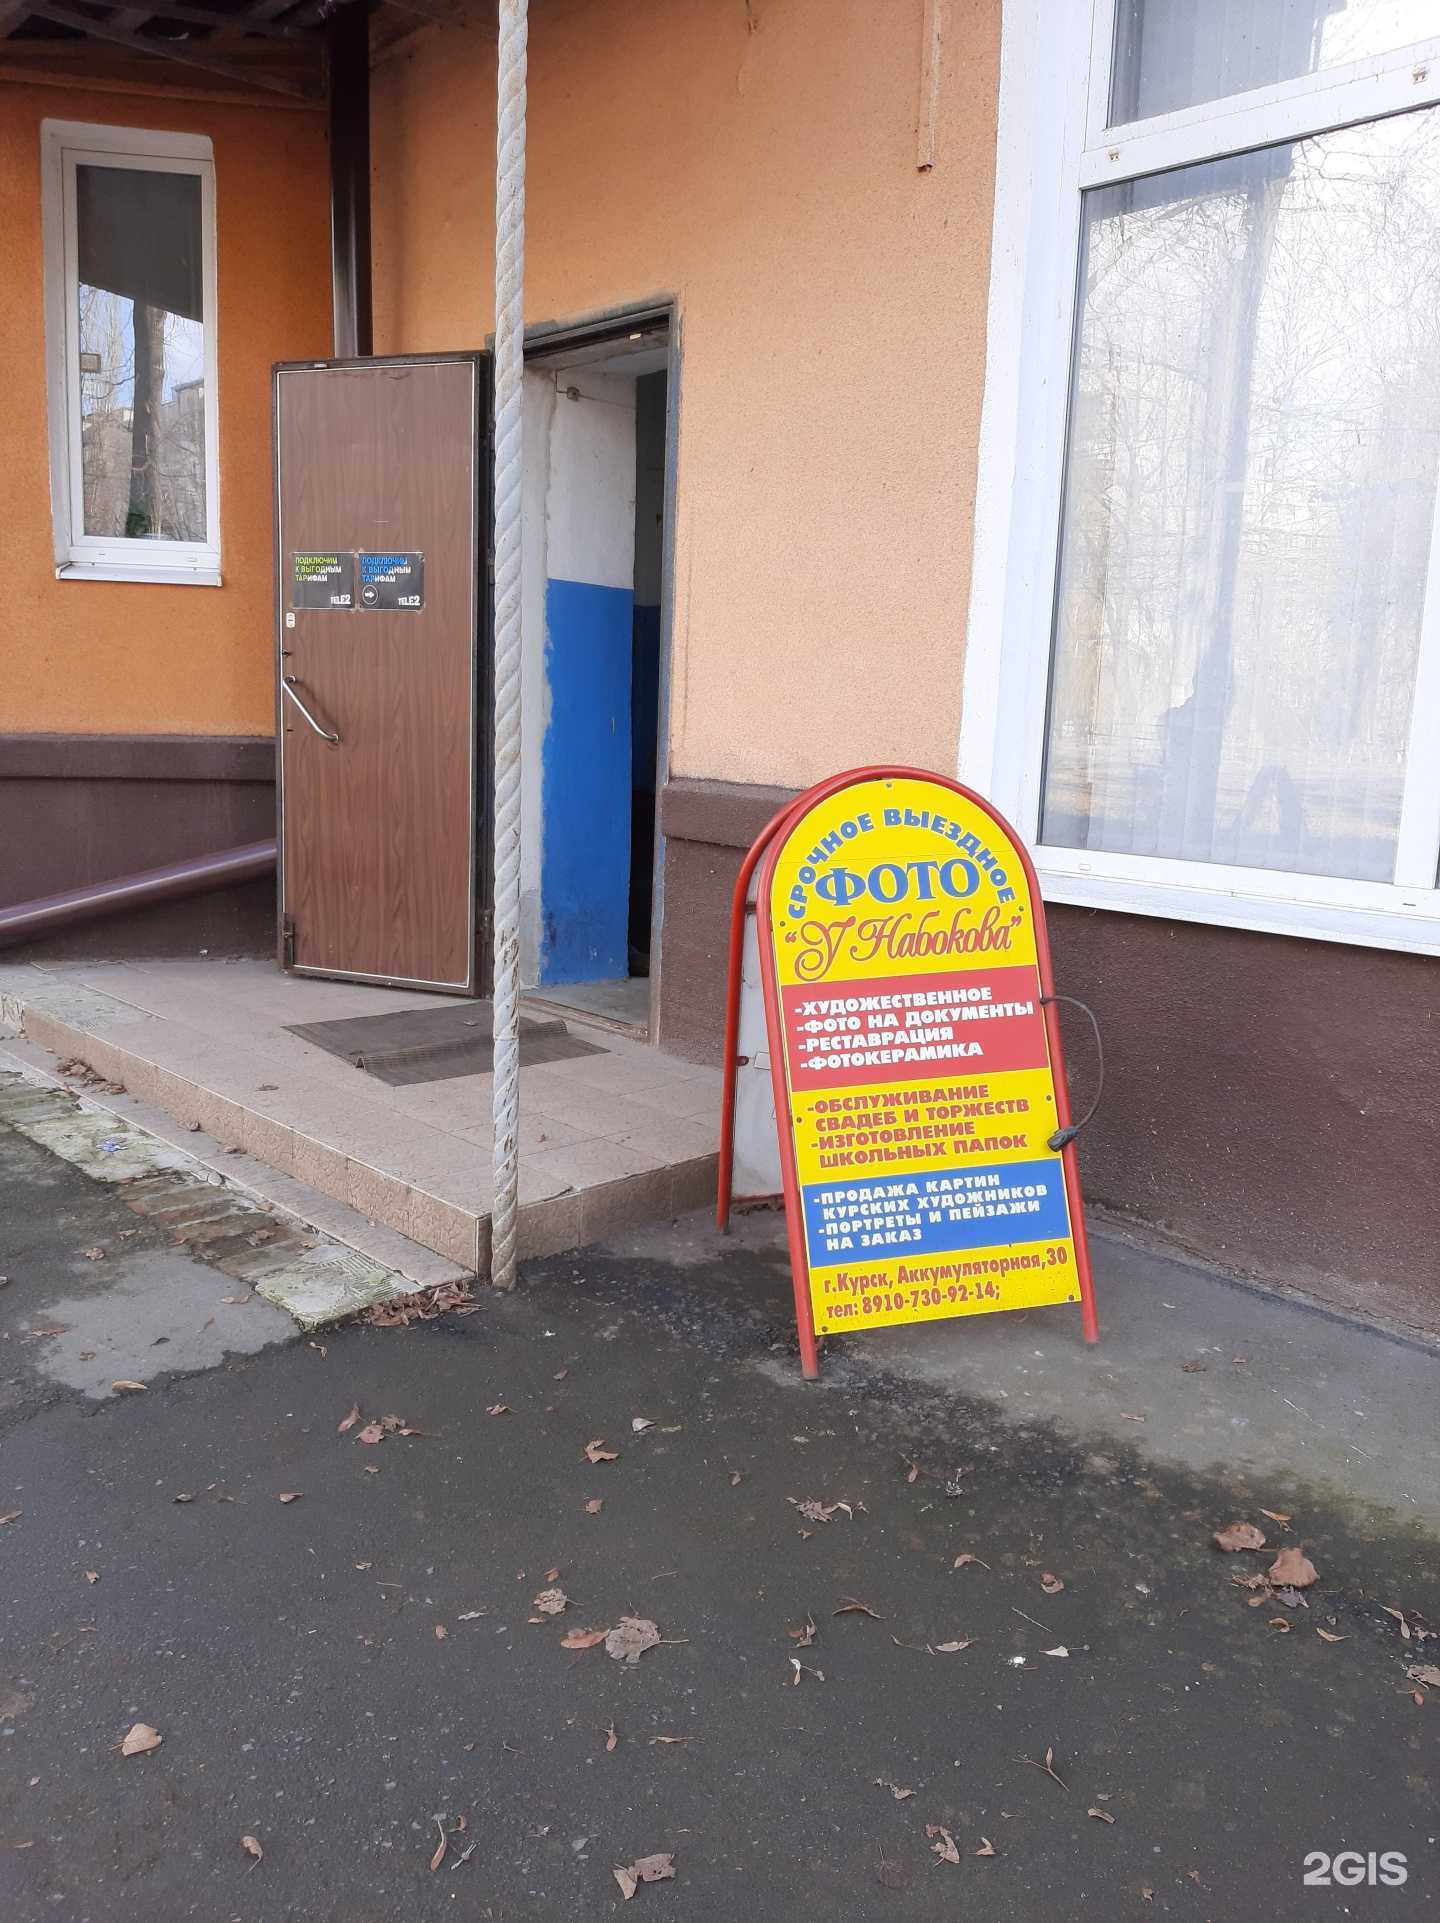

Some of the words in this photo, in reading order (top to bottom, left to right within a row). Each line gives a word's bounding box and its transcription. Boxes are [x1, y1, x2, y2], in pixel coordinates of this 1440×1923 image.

[362, 575, 395, 583] ТАРИФАМ
[369, 566, 411, 574] ВЫГОДНЫМ
[331, 594, 351, 605] TELE2
[398, 595, 420, 606] TELE2
[788, 813, 874, 919] СРОЧНОЕ
[883, 809, 1015, 904] ВЫЕЗДНОЕ
[815, 858, 980, 907] ФОТО
[795, 987, 992, 1016] -ХУДОЖЕСТВЕННОЕ
[797, 1015, 861, 1034] -ФОТО
[868, 1013, 899, 1027] НА
[905, 1002, 1034, 1027] ДОКУМЕНТЫ
[798, 1026, 953, 1052] -РЕСТАВРАЦИЯ
[800, 1042, 983, 1070] -ФОТОКЕРАМИКА
[807, 1085, 989, 1114] -ОБСЛУЖИВАНИЕ
[816, 1111, 897, 1132] СВАДЕБ
[904, 1109, 919, 1123] И
[927, 1099, 1029, 1121] ТОРЖЕСТВ
[811, 1122, 975, 1150] -ИЗГОТОВЛЕНИЕ
[820, 1142, 947, 1169] ШКОЛЬНЫХ
[954, 1135, 1028, 1153] ПАПОК
[814, 1182, 919, 1204] -ПРОДАЖА
[926, 1174, 1000, 1193] КАРТИН
[823, 1200, 910, 1220] КУРСКИХ
[917, 1184, 1047, 1210] ХУДОЖНИКОВ
[818, 1213, 922, 1235] -ПОРТРЕТЫ
[929, 1211, 942, 1224] И
[949, 1199, 1040, 1221] ПЕЙЗАЖИ
[826, 1237, 853, 1251] НА
[861, 1228, 922, 1246] ЗАКАЗ
[826, 1301, 858, 1319] тел:
[863, 1283, 1000, 1314] 8910-730-92-14;
